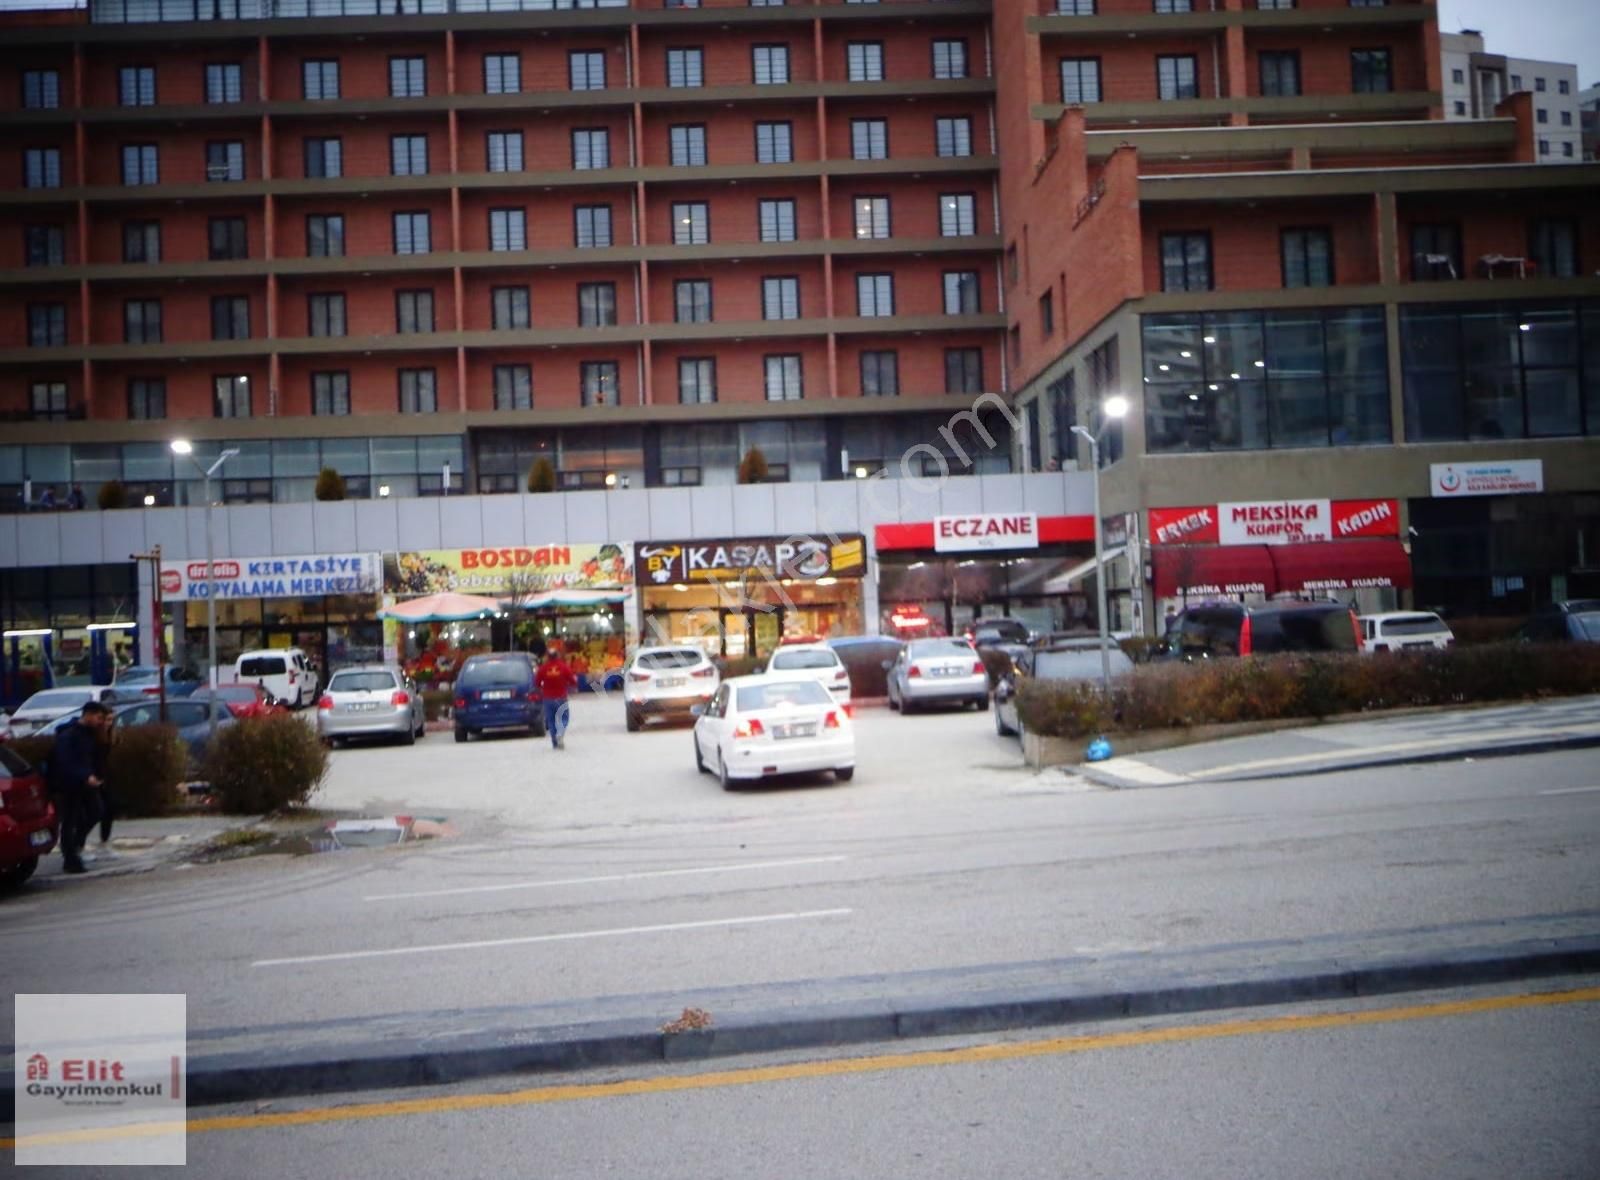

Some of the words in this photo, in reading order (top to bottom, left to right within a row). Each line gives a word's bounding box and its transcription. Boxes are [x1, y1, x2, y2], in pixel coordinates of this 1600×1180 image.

[1232, 502, 1318, 522] MEKSİKA
[1338, 502, 1391, 535] KADIN
[940, 517, 1032, 537] ECZANE
[1156, 508, 1212, 543] ERKEK
[461, 547, 571, 569] BOSDAN
[648, 556, 674, 571] BY
[689, 545, 796, 574] KASAP
[188, 579, 285, 598] KOPYALAMA
